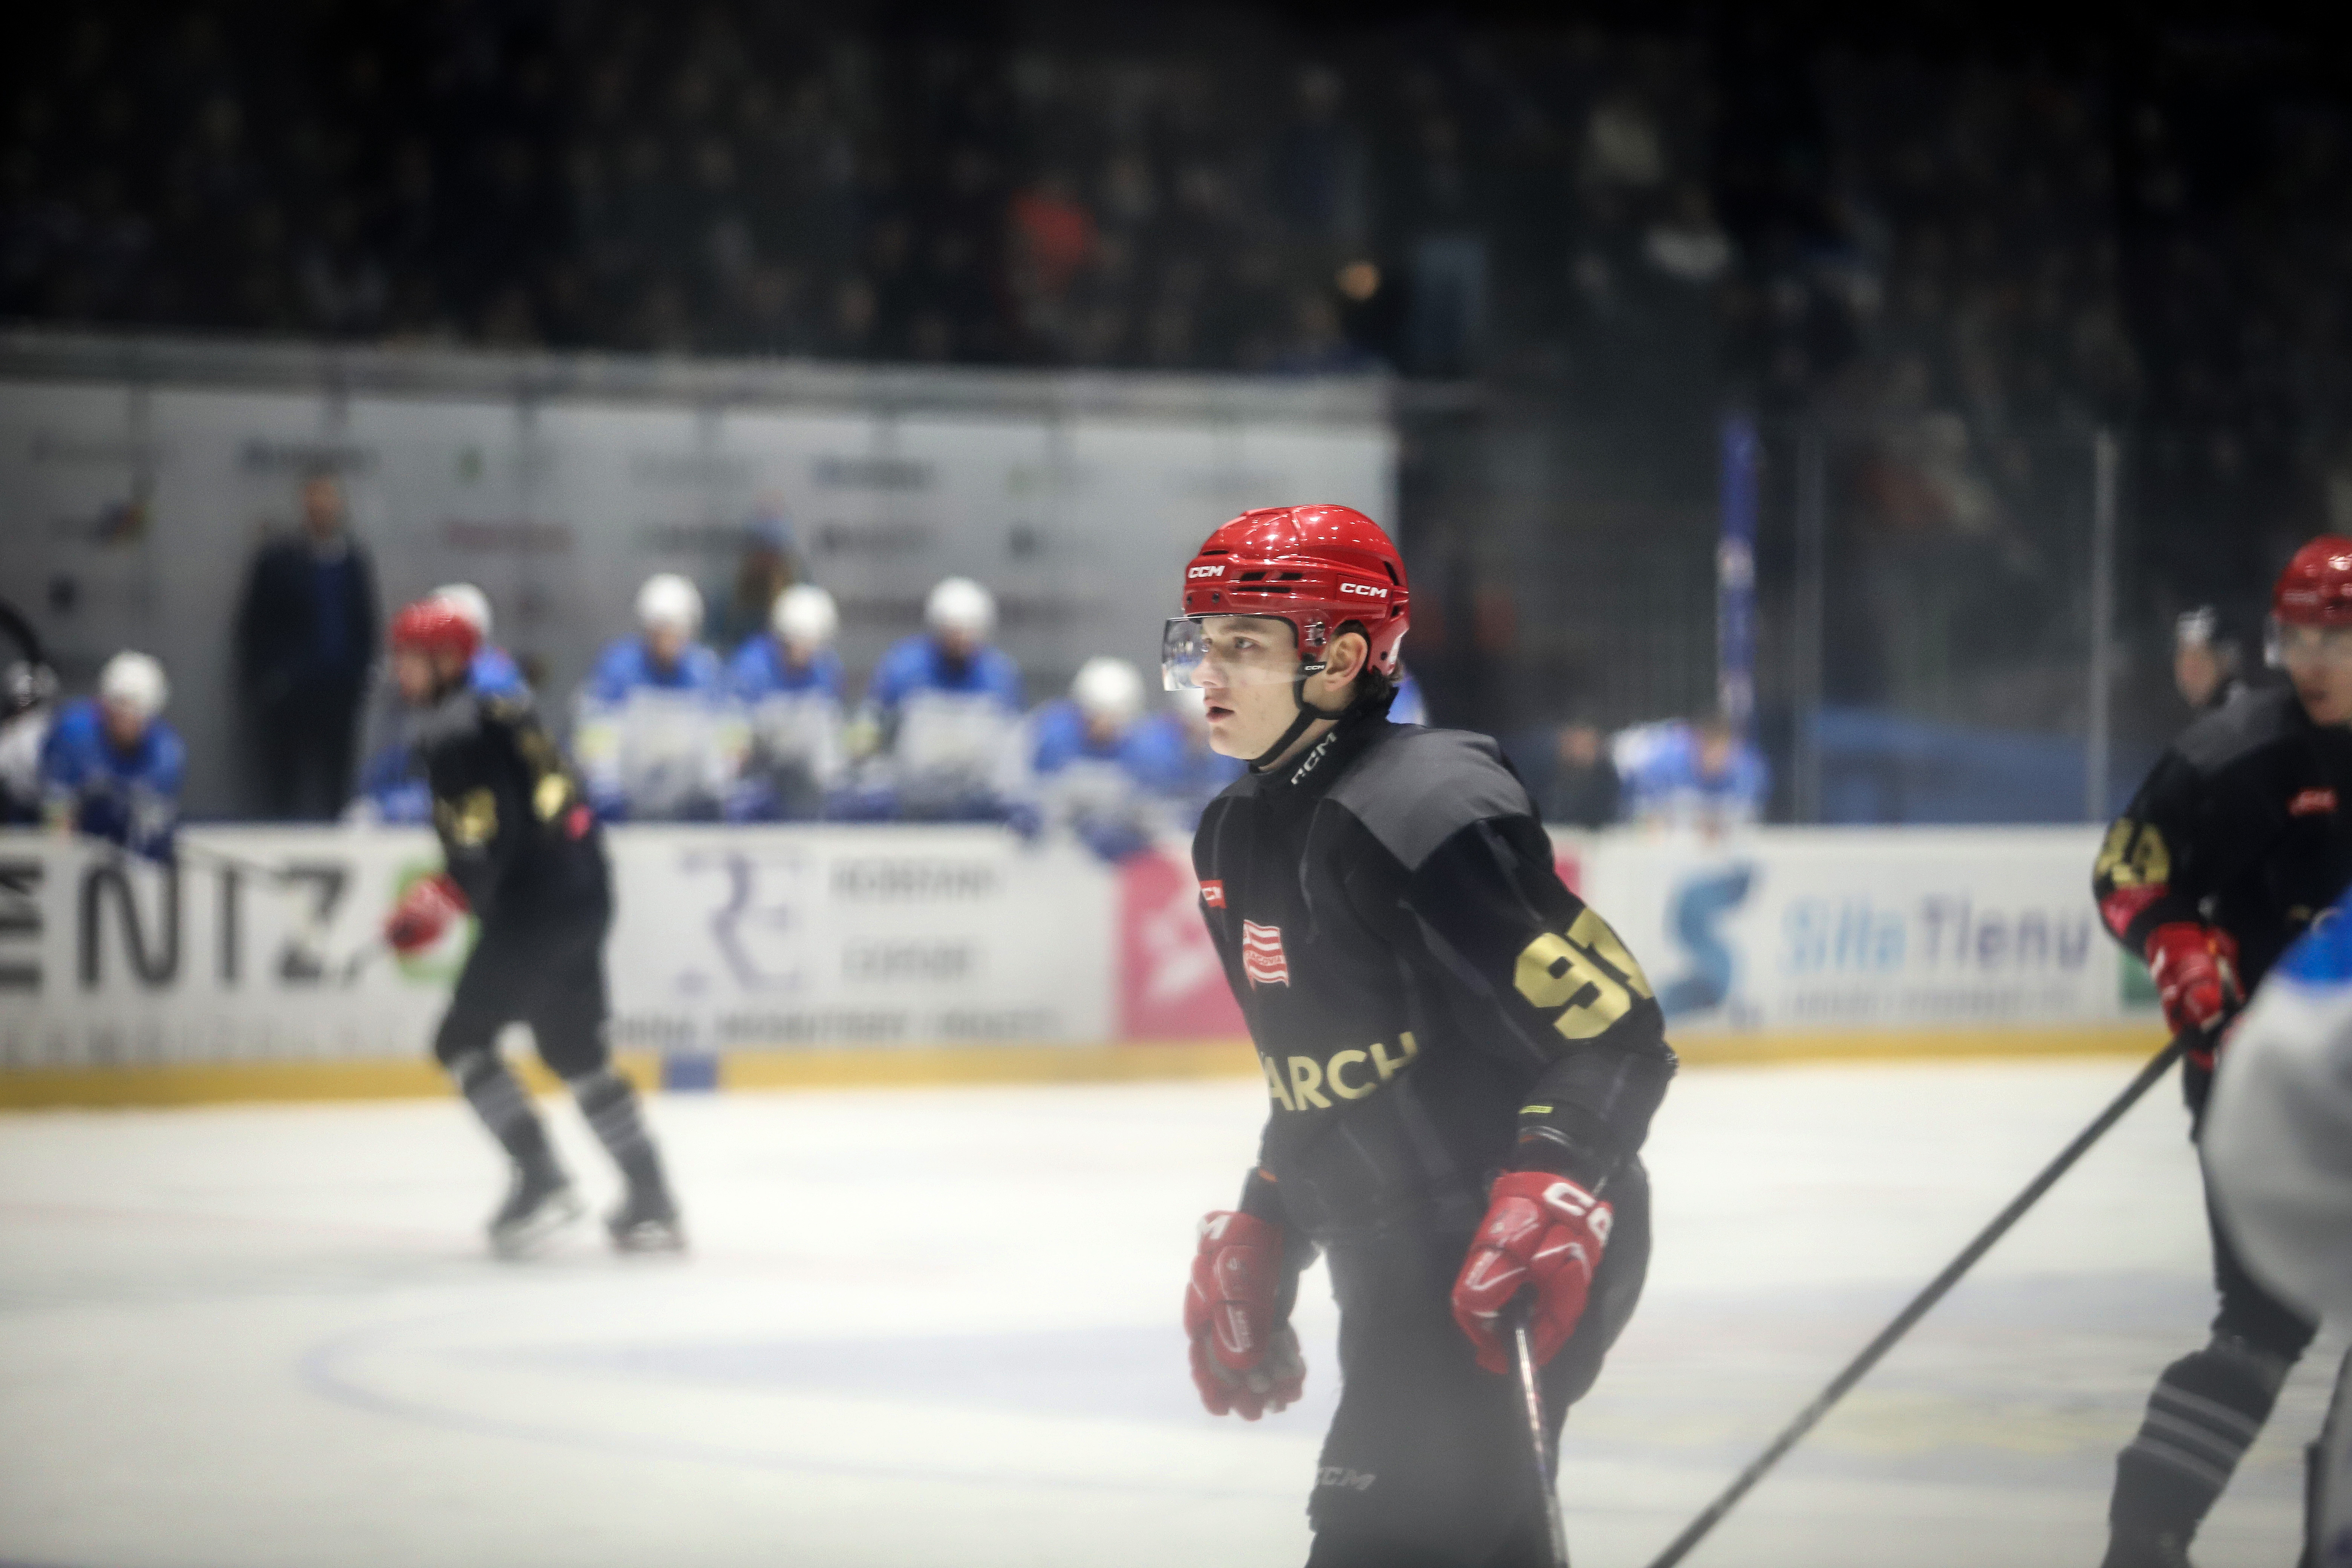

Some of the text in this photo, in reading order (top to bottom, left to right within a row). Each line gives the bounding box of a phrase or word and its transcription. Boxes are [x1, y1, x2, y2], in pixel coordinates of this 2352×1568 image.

[1188, 565, 1225, 579] CCM
[1340, 583, 1387, 598] CCM
[1264, 1031, 1418, 1111] ARCH
